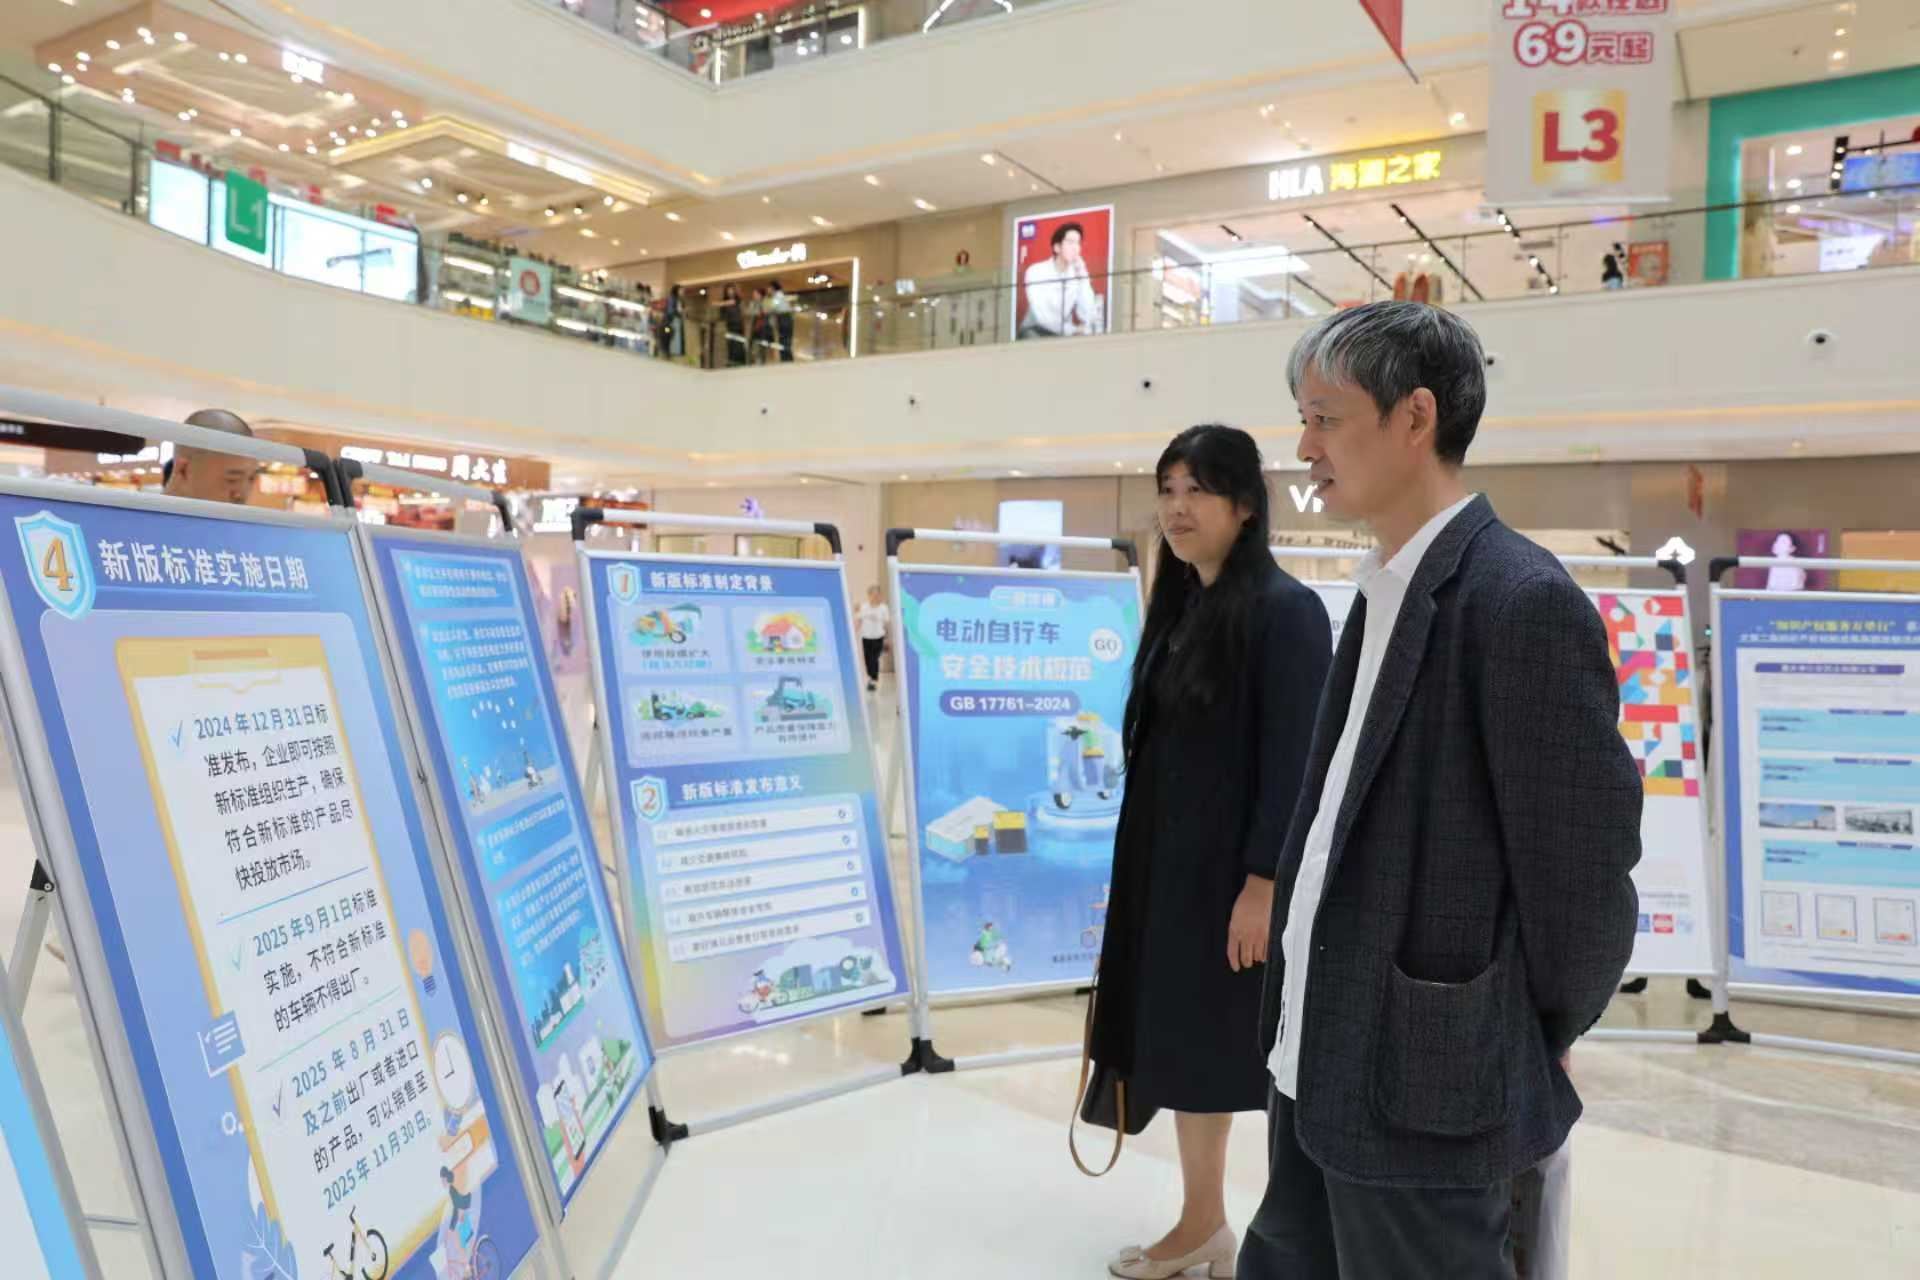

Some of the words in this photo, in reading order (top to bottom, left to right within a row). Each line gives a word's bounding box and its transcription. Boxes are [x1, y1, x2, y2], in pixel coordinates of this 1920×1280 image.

[1514, 18, 1653, 66] 69元起
[1542, 108, 1620, 164] L3
[1268, 165, 1324, 200] HLA
[231, 188, 265, 240] L1
[43, 537, 73, 592] 4
[98, 539, 309, 590] 新版标准实施日期
[650, 571, 773, 592] 新版标准制定背景
[936, 617, 1061, 645] 电动自行车
[942, 655, 1092, 681] 安全技术规范
[950, 696, 975, 711] GB
[203, 735, 337, 779] 准发布，企业即可按照
[213, 766, 347, 816] 新标准组织生产，确保
[641, 785, 657, 812] 2
[682, 774, 803, 801] 新版标准发布意义
[224, 798, 353, 854] 符合新标准的产品尽
[234, 848, 312, 892] 快投放市场。
[273, 966, 370, 1033] 的车辆不得出厂。
[302, 1039, 420, 1137] 及之前出厂或者进口
